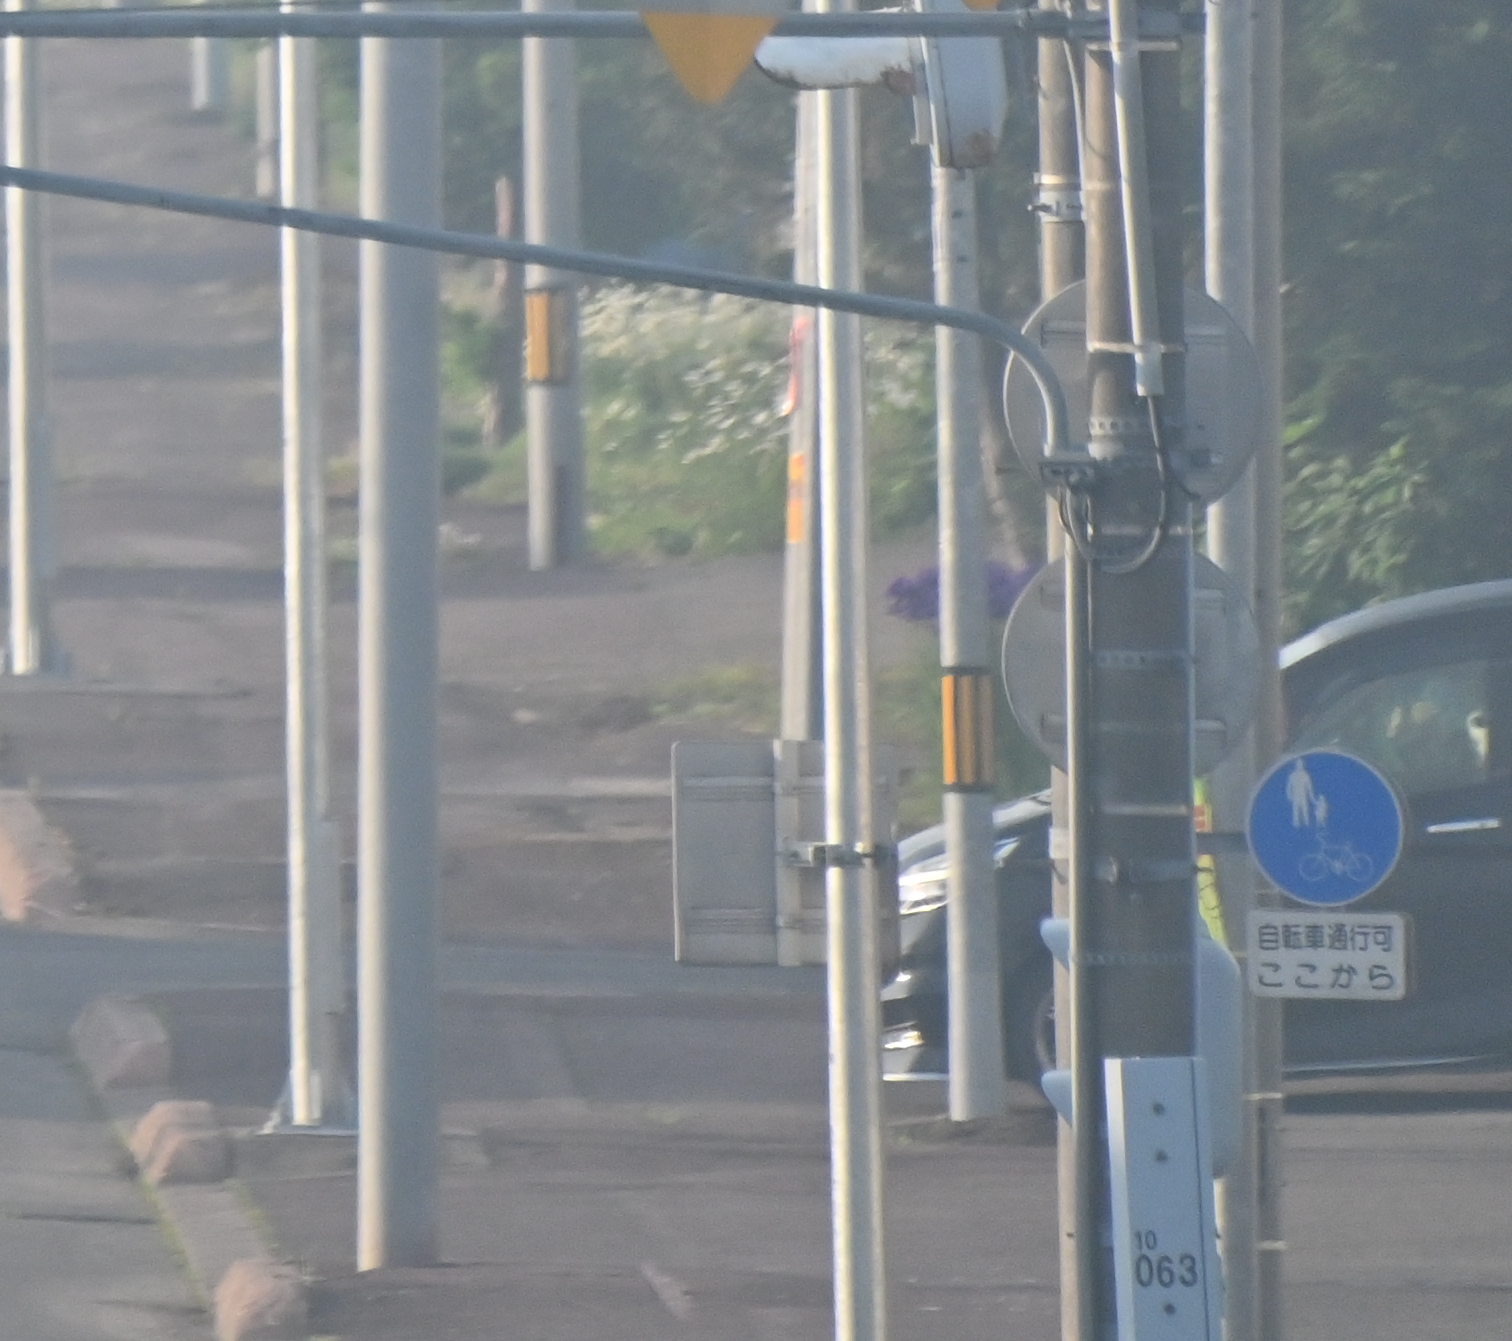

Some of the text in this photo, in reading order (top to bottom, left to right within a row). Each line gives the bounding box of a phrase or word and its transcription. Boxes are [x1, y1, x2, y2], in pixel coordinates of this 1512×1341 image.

[1257, 922, 1394, 953] 自転車通行可
[1257, 962, 1395, 990] ここから
[1133, 1229, 1158, 1252] 10
[1134, 1253, 1199, 1289] 063
